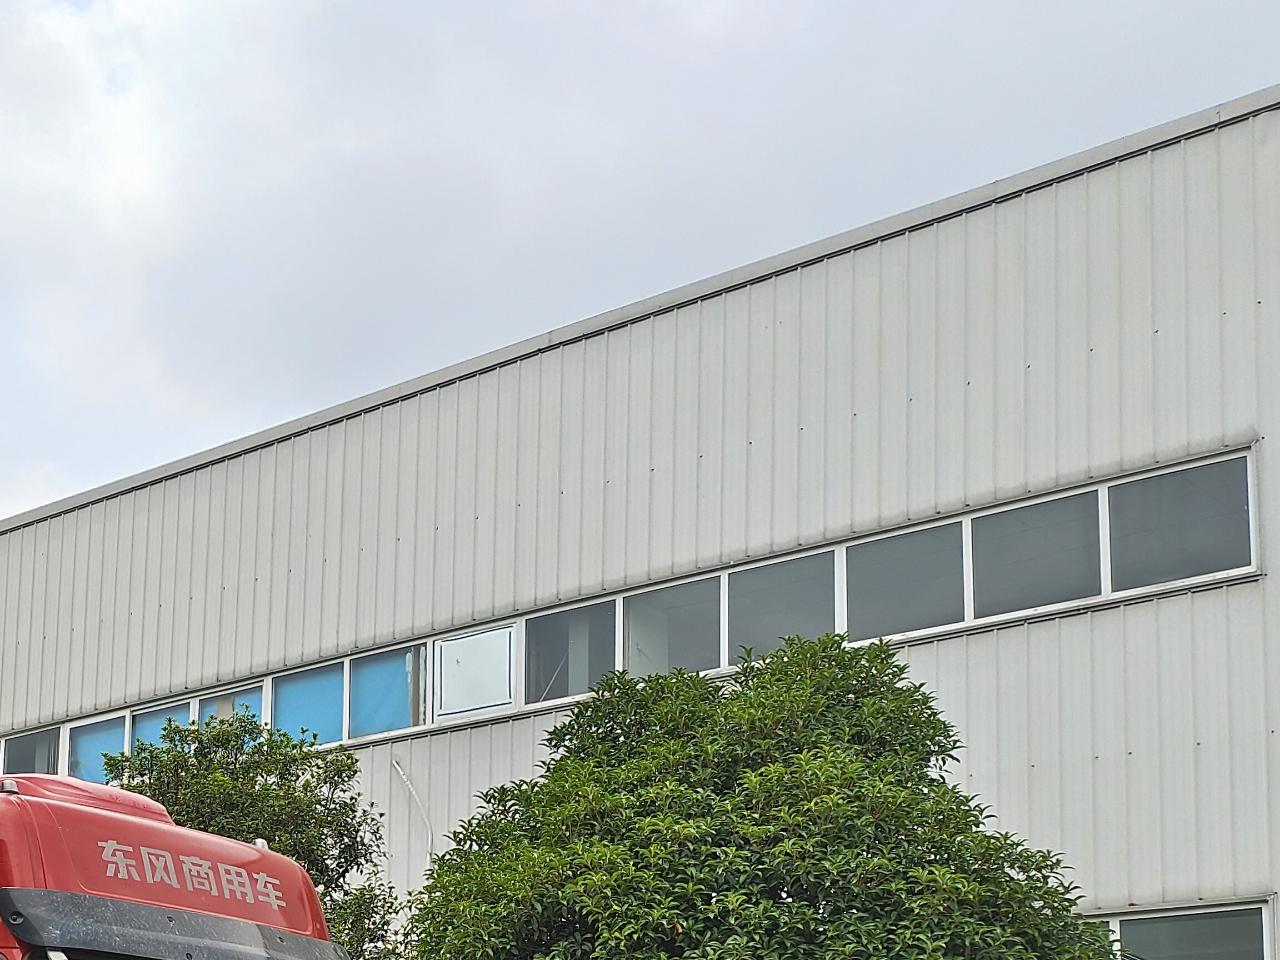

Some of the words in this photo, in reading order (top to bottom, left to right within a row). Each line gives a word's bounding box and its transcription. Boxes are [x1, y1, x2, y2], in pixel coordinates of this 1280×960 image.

[97, 839, 287, 911] 东风商用车
